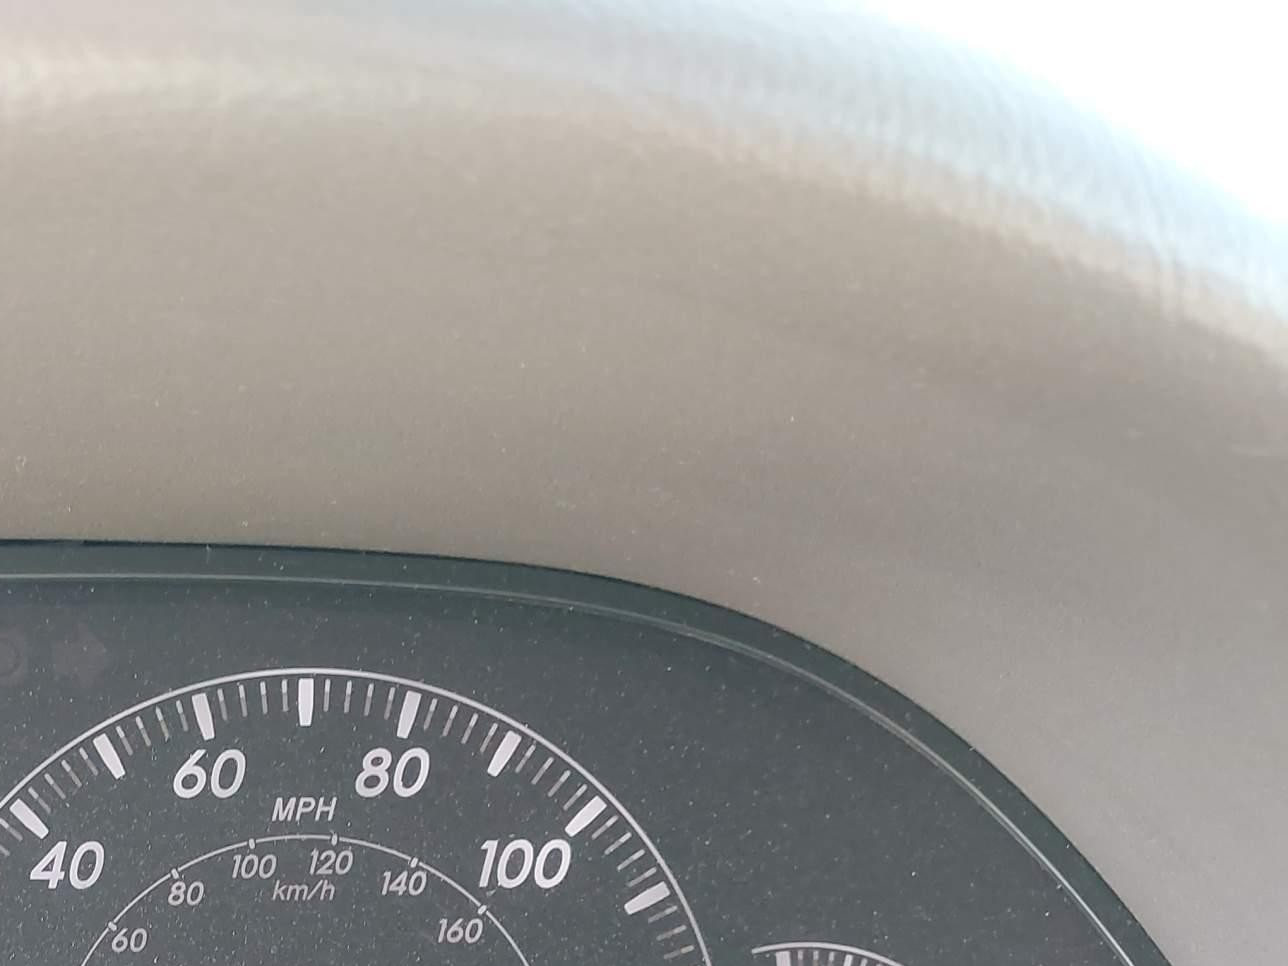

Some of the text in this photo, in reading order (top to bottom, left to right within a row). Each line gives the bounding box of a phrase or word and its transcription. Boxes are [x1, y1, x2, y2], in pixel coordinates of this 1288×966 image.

[173, 749, 246, 798] 60
[355, 747, 430, 798] 80
[271, 797, 337, 822] MPH
[29, 840, 105, 889] 40
[231, 854, 277, 879] 100
[309, 849, 354, 875] 120
[478, 839, 571, 889] 100
[168, 882, 204, 906] 80
[272, 880, 336, 901] km/h
[381, 870, 427, 896] 140
[112, 928, 148, 952] 60
[438, 918, 483, 944] 160
